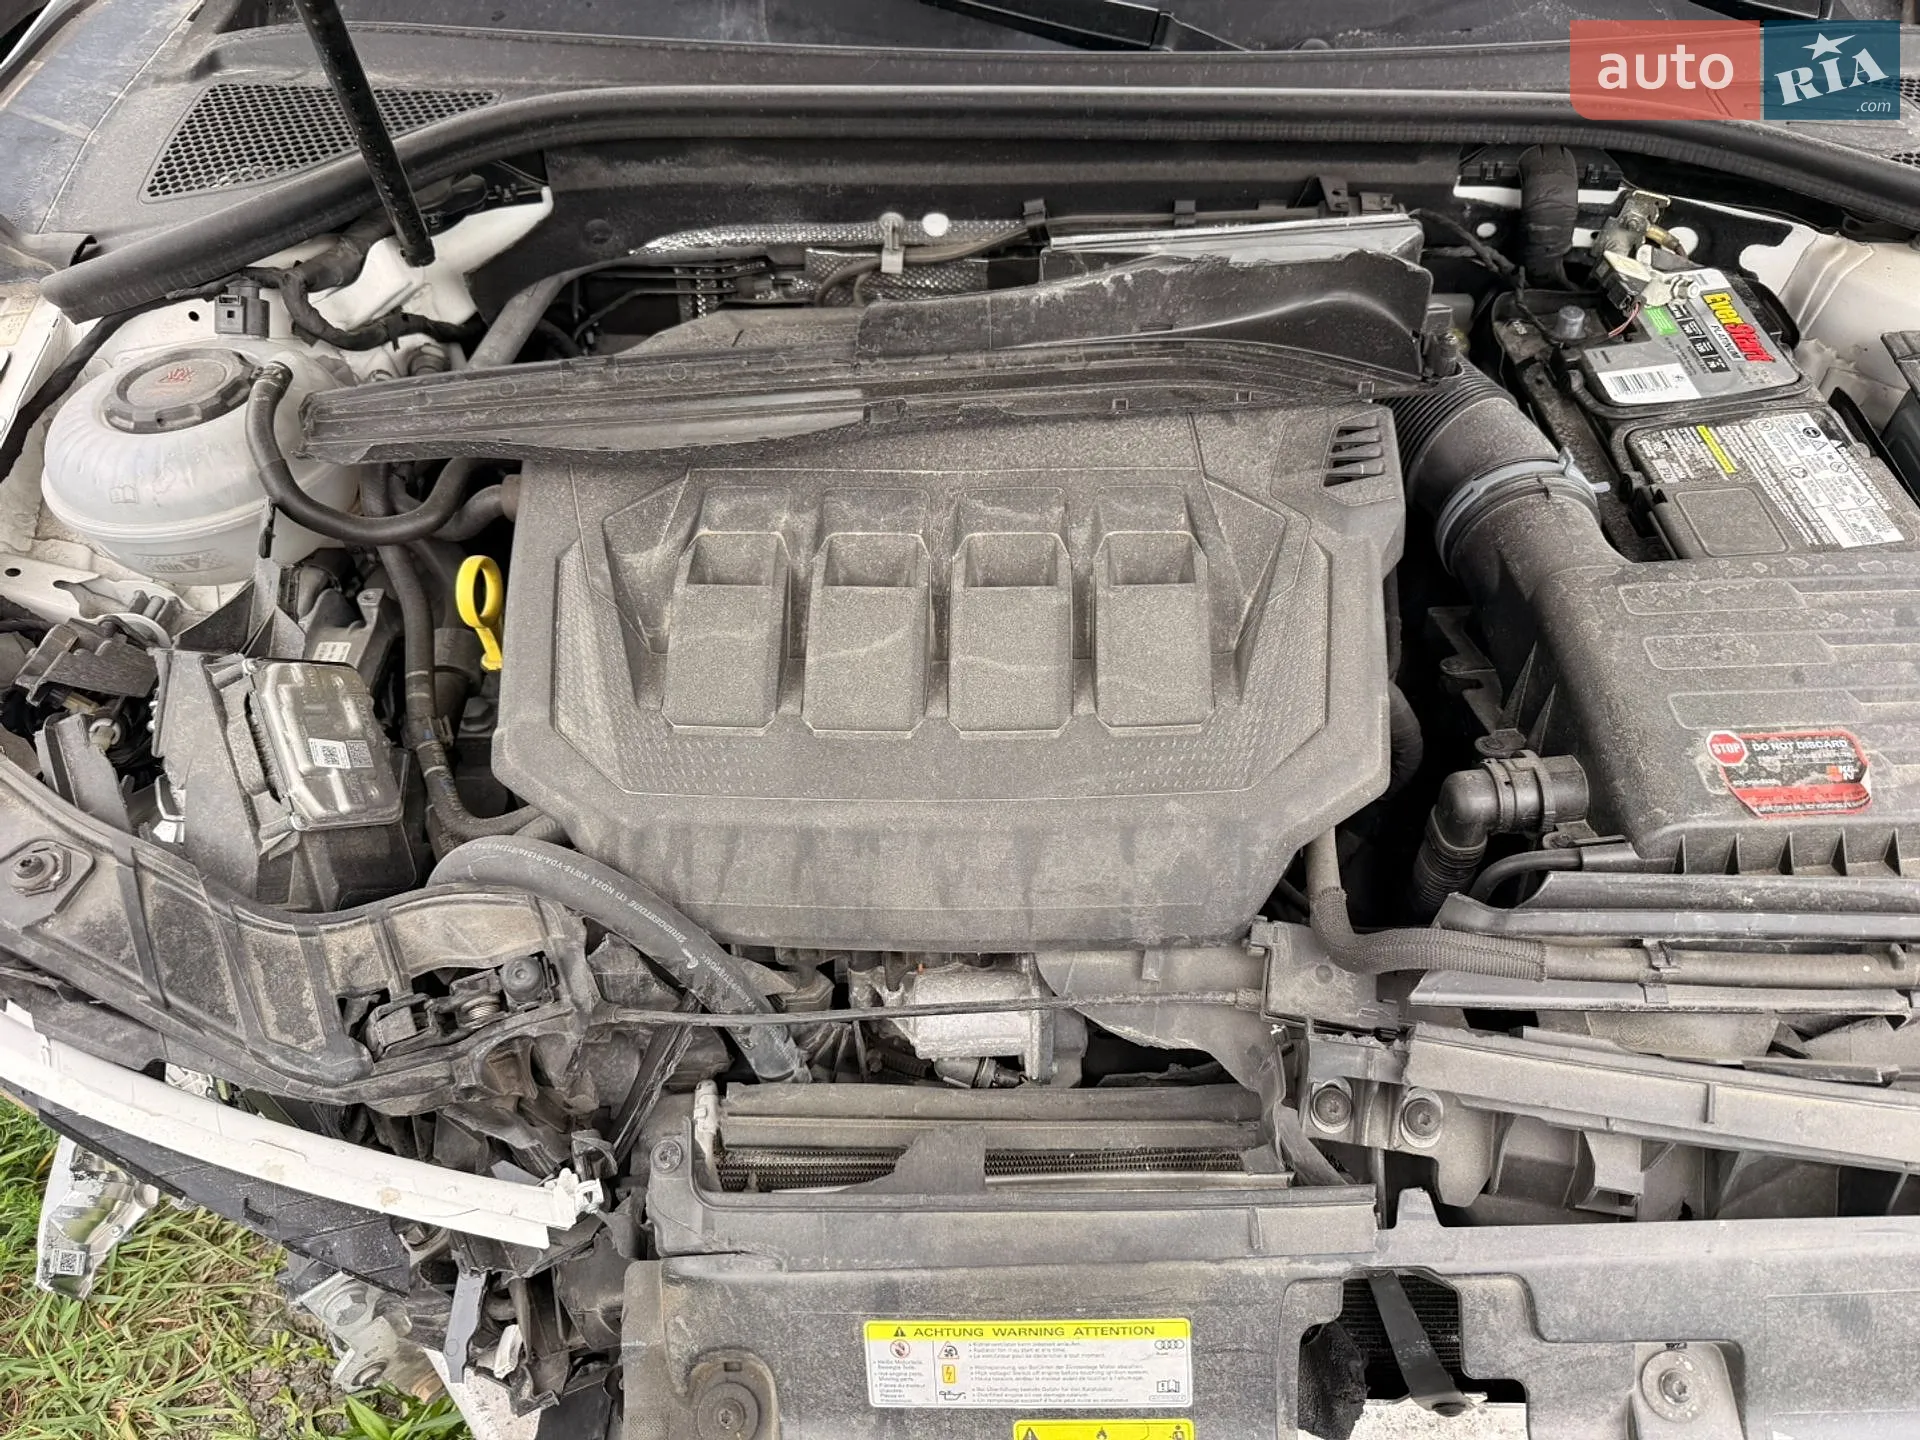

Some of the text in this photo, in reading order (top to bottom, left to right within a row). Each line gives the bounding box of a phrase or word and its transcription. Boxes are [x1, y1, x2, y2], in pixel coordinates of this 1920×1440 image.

[1711, 325, 1741, 361] PLATINUM
[1712, 743, 1741, 754] STOP
[1752, 739, 1848, 752] DO NOT DISCARD
[913, 1325, 1156, 1338] ACHTUNG WARNING ATTENTION
